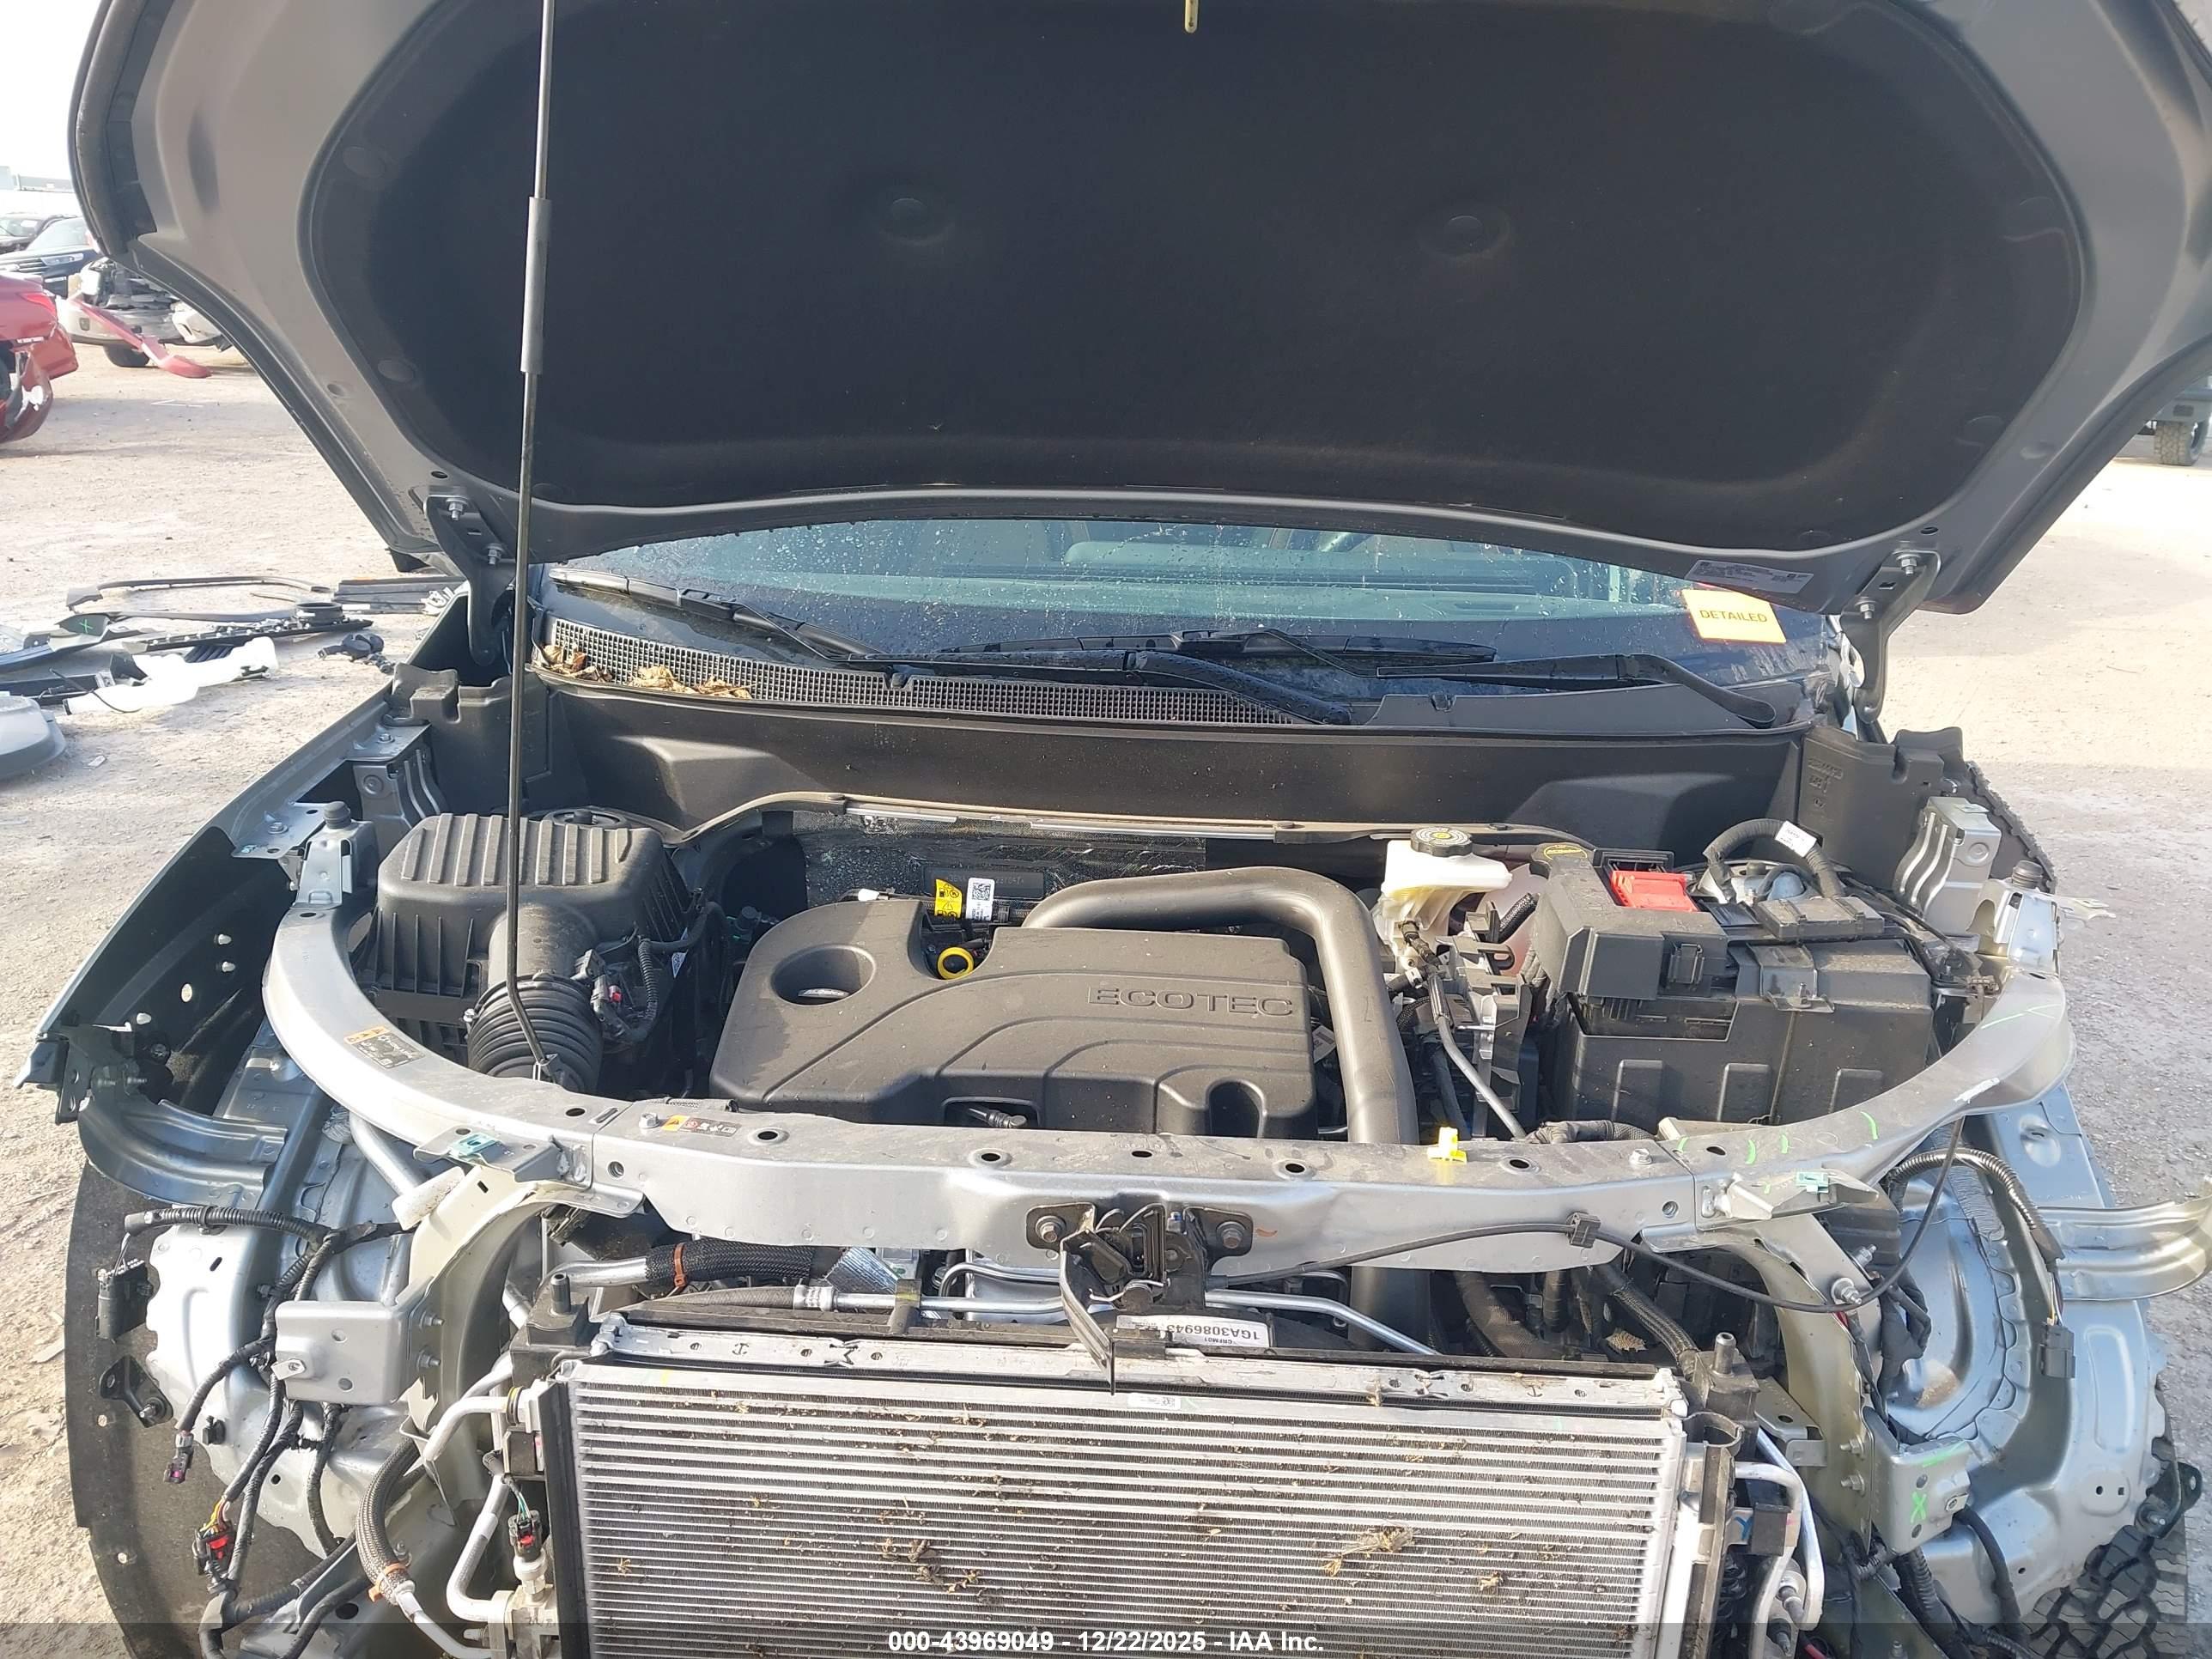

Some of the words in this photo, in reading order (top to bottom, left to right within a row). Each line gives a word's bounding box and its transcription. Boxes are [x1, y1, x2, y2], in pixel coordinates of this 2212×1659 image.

[1700, 610, 1767, 623] DETAILED
[1088, 985, 1293, 1016] ECOTEC
[1166, 1324, 1261, 1340] 1GA3086943
